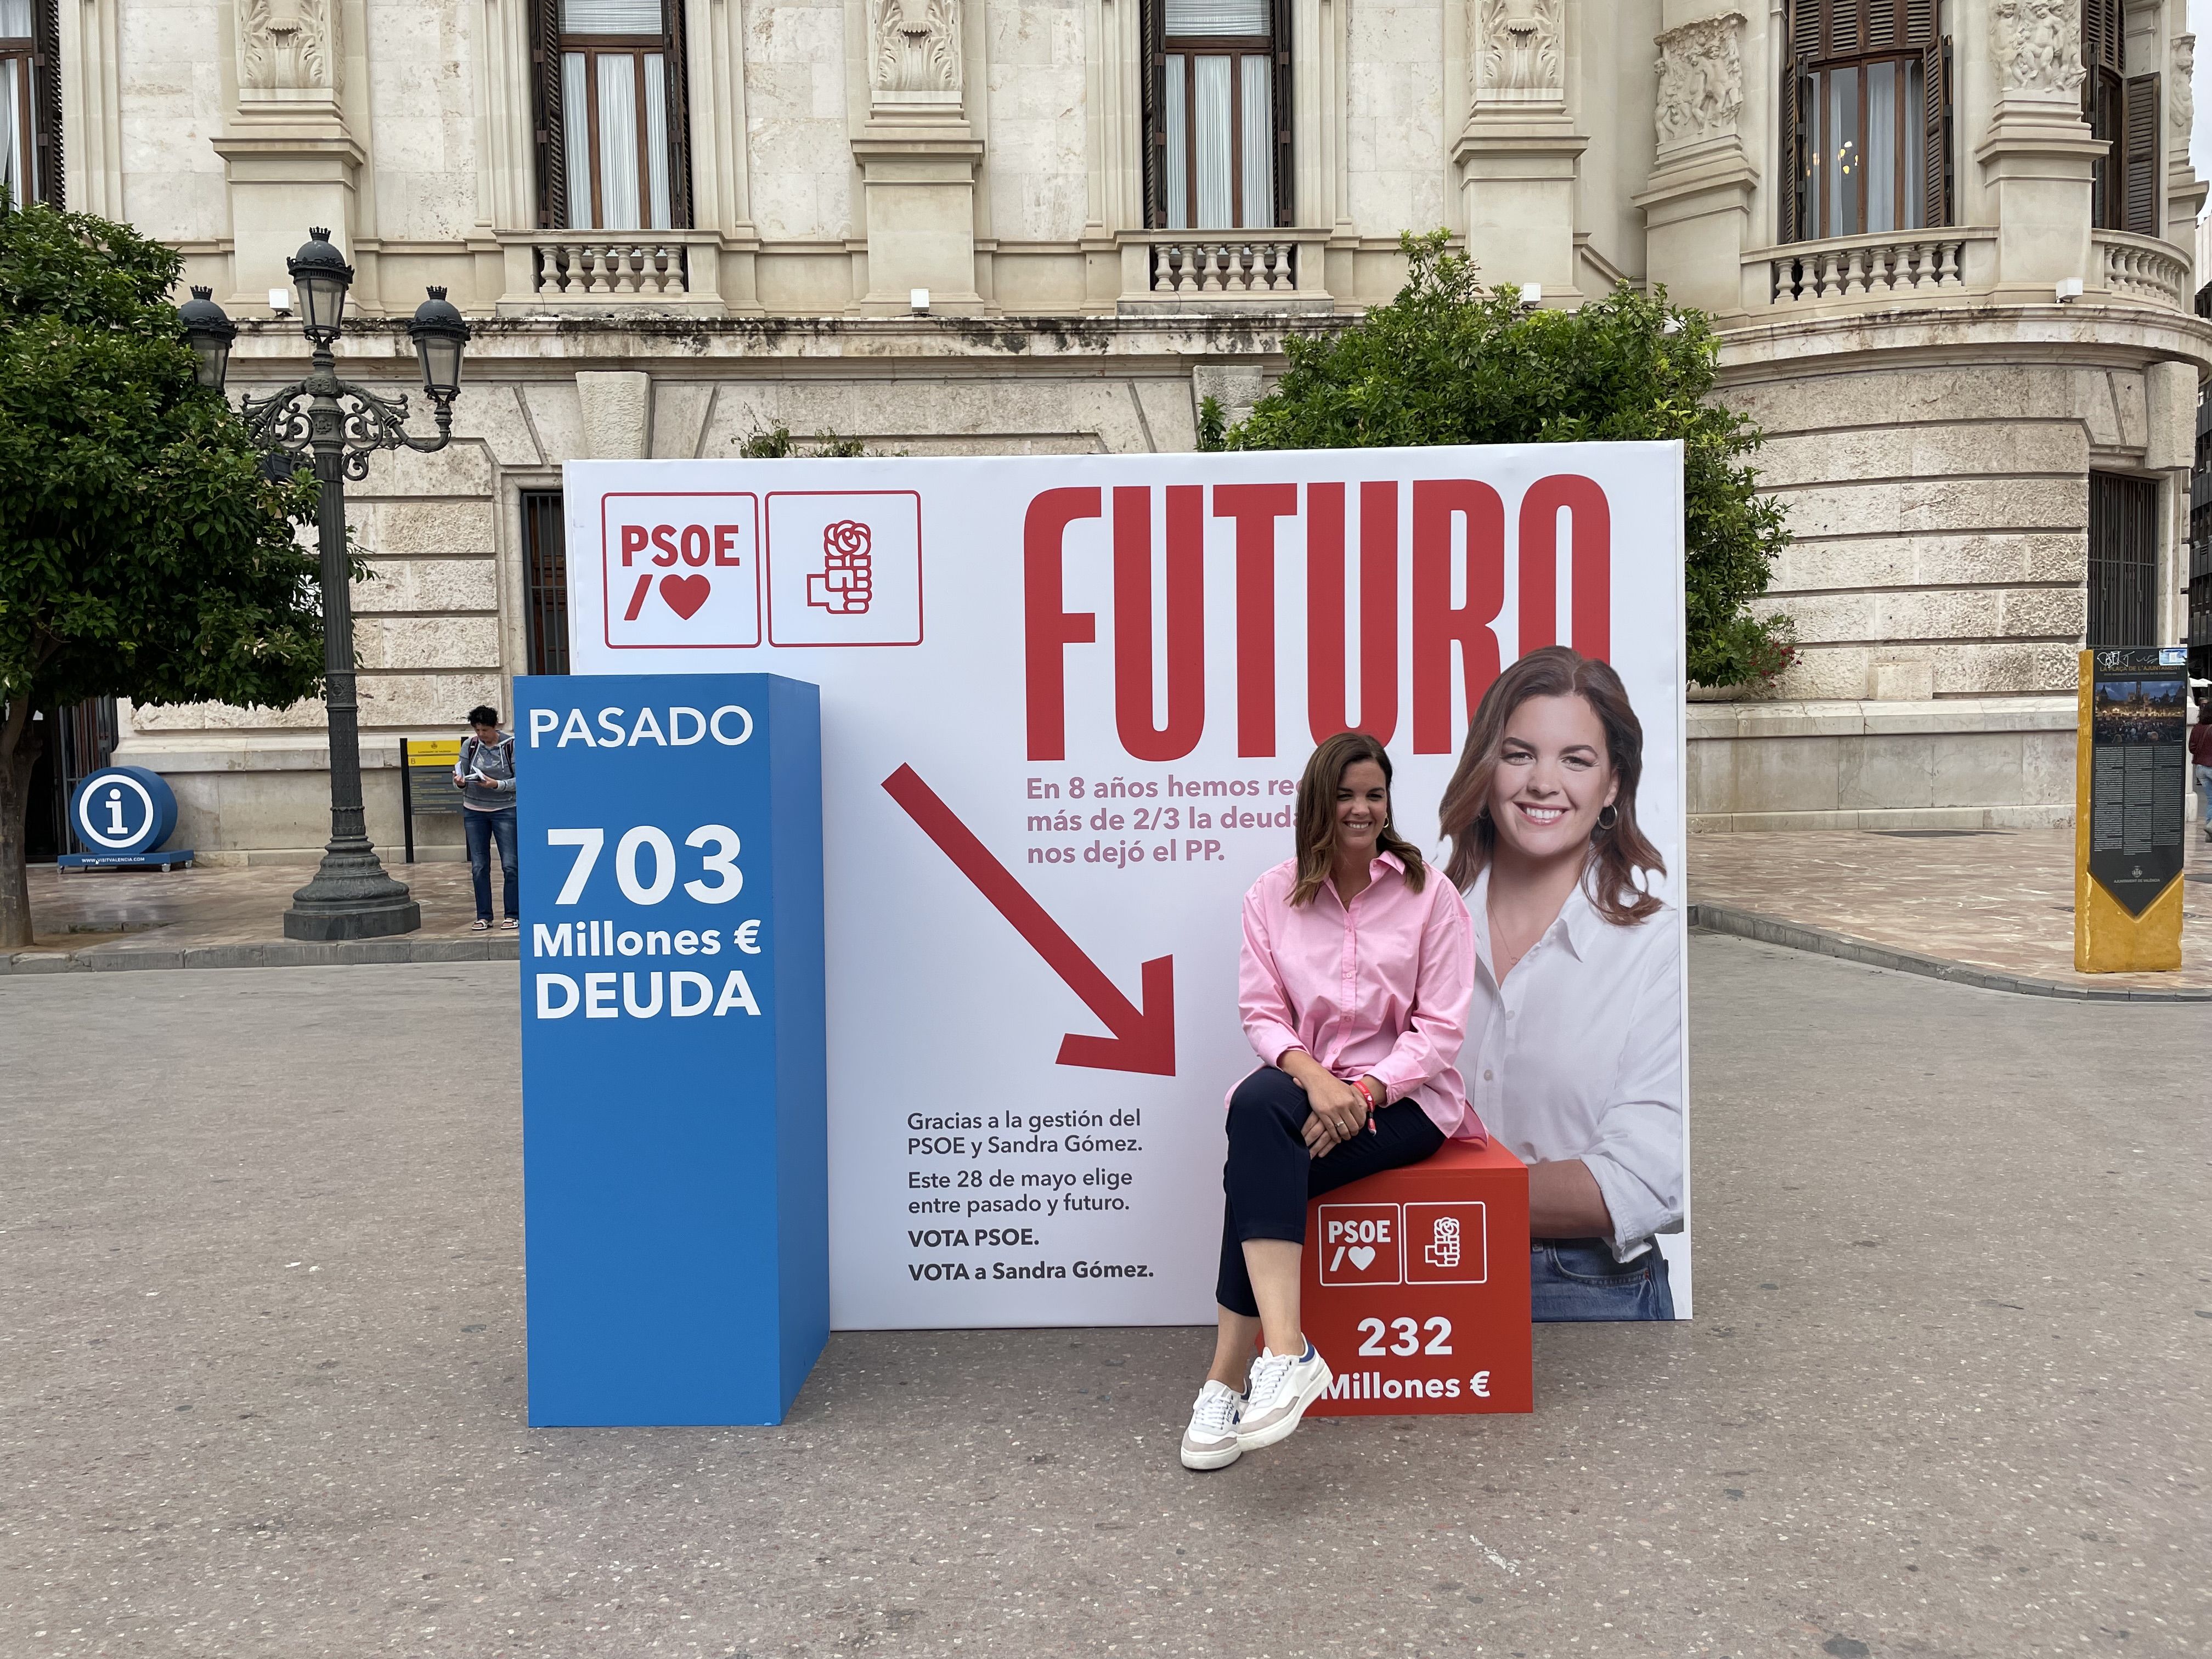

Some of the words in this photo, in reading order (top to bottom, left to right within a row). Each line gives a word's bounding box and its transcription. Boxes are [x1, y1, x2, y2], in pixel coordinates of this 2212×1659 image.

[622, 524, 740, 567] PSOE
[1024, 475, 1610, 761] FUTURO
[530, 705, 753, 748] PASADO
[1028, 778, 1059, 799] En
[1069, 777, 1085, 799] 8
[1094, 777, 1158, 798] años
[1168, 775, 1259, 797] hemos
[1028, 810, 1081, 831] más
[1090, 808, 1124, 831] de
[1135, 807, 1179, 830] 2/3
[1189, 807, 1212, 828] la
[548, 824, 743, 905] 703
[1029, 848, 1074, 863] nos
[1084, 840, 1144, 869] dejó
[1153, 839, 1177, 862] el
[1186, 839, 1223, 861] PP.
[533, 921, 721, 957] Millones
[733, 919, 761, 954] €
[536, 970, 761, 1019] DEUDA
[908, 1112, 981, 1130] Gracias
[988, 1117, 999, 1128] a
[1006, 1110, 1022, 1128] la
[1029, 1110, 1103, 1133] gestión
[1109, 1108, 1140, 1126] del
[909, 1137, 966, 1155] PSOE
[971, 1142, 983, 1159] y
[988, 1135, 1058, 1153] Sandra
[1064, 1135, 1142, 1152] Gómez.
[909, 1171, 951, 1189] Este
[957, 1170, 983, 1188] 28
[989, 1169, 1015, 1187] de
[1022, 1173, 1076, 1191] mayo
[1082, 1167, 1132, 1190] elige
[909, 1198, 961, 1214] entre
[967, 1193, 1041, 1218] pasado
[1047, 1199, 1058, 1216] y
[1063, 1193, 1130, 1211] futuro.
[908, 1229, 969, 1248] VOTA
[975, 1228, 1039, 1246] PSOE.
[1328, 1220, 1391, 1244] PSOE
[908, 1263, 970, 1281] VOTA
[974, 1267, 986, 1280] a
[992, 1260, 1066, 1280] Sandra
[1072, 1261, 1154, 1278] Gómez.
[1357, 1316, 1453, 1356] 232
[1321, 1372, 1460, 1400] Millones
[1469, 1370, 1491, 1397] €
